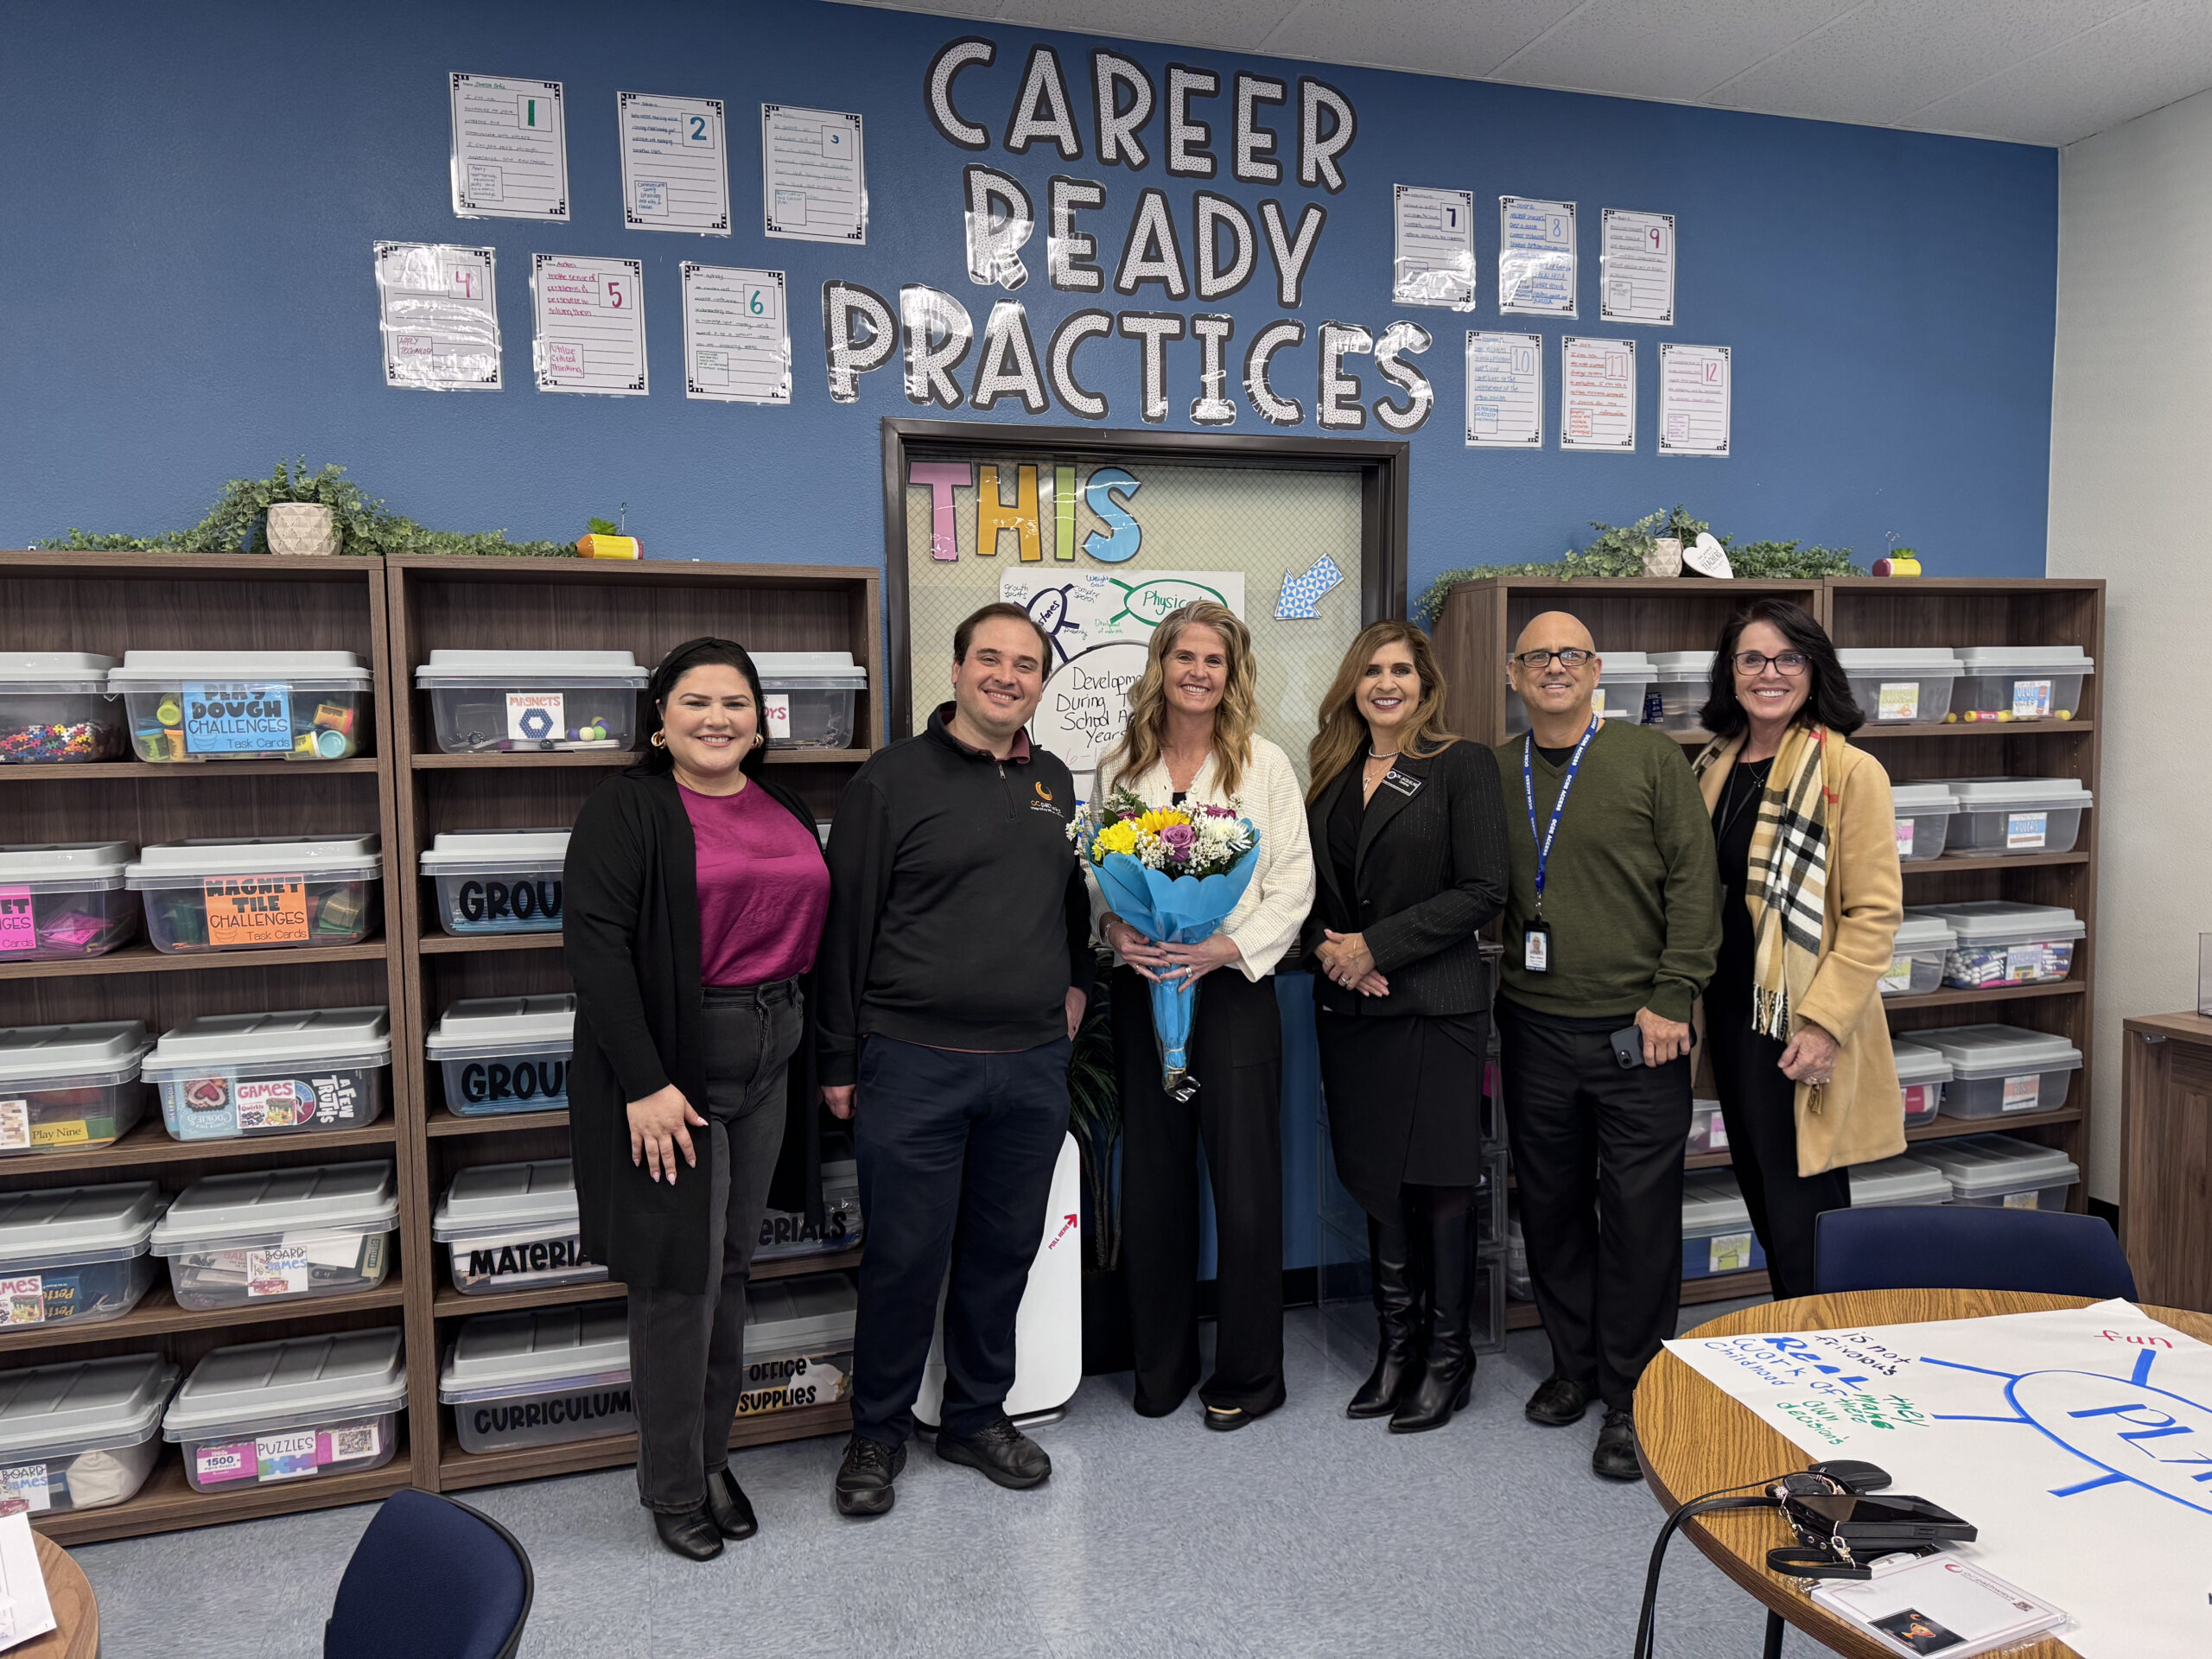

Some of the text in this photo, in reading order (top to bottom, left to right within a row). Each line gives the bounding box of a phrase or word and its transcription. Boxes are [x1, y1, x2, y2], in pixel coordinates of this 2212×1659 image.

[925, 35, 1356, 195] CAREER
[690, 117, 707, 140] 2
[830, 134, 840, 144] 3
[1446, 207, 1456, 227] 7
[963, 163, 1326, 308] READY
[1553, 218, 1561, 238] 8
[1649, 228, 1660, 249] 9
[455, 270, 471, 298] 4
[607, 282, 622, 308] 5
[750, 290, 764, 315] 6
[551, 354, 575, 363] Critical
[823, 281, 1433, 432] PRACTICES
[1513, 348, 1530, 373] 10
[1607, 355, 1626, 378] 11
[551, 364, 582, 375] Thinking
[1706, 363, 1718, 382] 12
[907, 460, 1142, 563] THIS
[1142, 590, 1202, 615] Physic
[1038, 600, 1060, 626] stones
[192, 701, 282, 719] DOUGH
[510, 696, 561, 707] MAGNETS
[1057, 693, 1106, 717] During
[188, 719, 289, 734] CHALLENGES
[1060, 710, 1109, 730] School
[226, 738, 290, 749] Task Cards
[1572, 746, 1585, 766] ACCESS
[1556, 790, 1567, 811] ACCESS
[1543, 835, 1553, 855] ACCESS
[205, 876, 302, 897] MAGNET
[232, 895, 280, 913] TILE
[459, 880, 562, 922] GROU
[0, 917, 31, 931] GES
[210, 911, 305, 928] CHALLENGES
[3, 938, 34, 948] Cards
[247, 930, 307, 941] Task Cards
[238, 1083, 293, 1098] GAMES
[461, 1060, 571, 1103] GROU
[311, 1075, 340, 1123] TRUTHS
[337, 1087, 357, 1117] FEW
[33, 1128, 81, 1141] Play Nine
[758, 1211, 847, 1245] ERIALS
[1048, 1224, 1070, 1250] PULL HERE
[223, 1251, 246, 1260] BAL
[265, 1248, 306, 1262] BOARD
[469, 1240, 594, 1276] MATERIA
[266, 1260, 307, 1272] GAMES
[0, 1278, 40, 1294] MES
[2093, 1330, 2173, 1349] fun
[1704, 1342, 1795, 1386] Childhood
[1866, 1345, 1912, 1364] not
[749, 1358, 807, 1382] OFFICE
[739, 1385, 817, 1412] SUPPLIES
[474, 1391, 632, 1434] CURRICULUM
[1802, 1400, 1840, 1421] own
[1884, 1395, 1930, 1427] they
[257, 1437, 315, 1457] PUZZLES
[206, 1456, 234, 1466] 1500
[2, 1466, 46, 1483] BOARD
